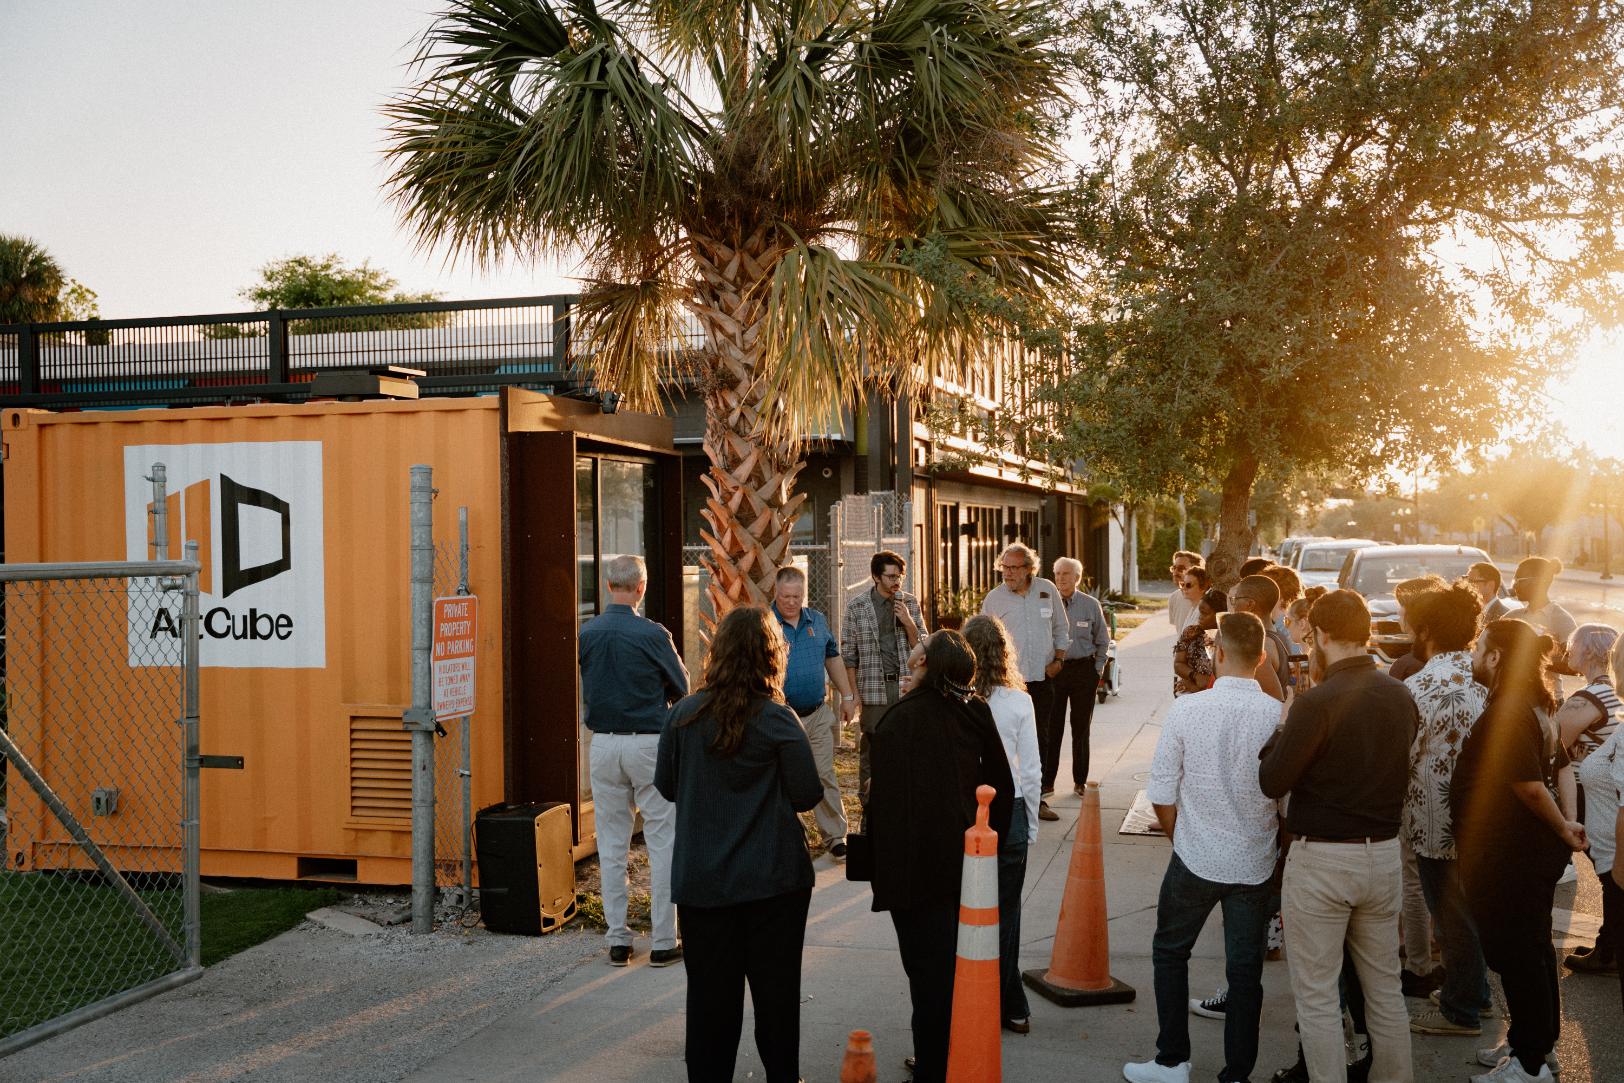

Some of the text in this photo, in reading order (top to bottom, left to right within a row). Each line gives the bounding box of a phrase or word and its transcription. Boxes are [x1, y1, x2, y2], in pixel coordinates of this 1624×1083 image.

[444, 603, 468, 619] PRIVATE
[440, 621, 471, 638] PROPERTY
[436, 638, 474, 657] NO PARKING
